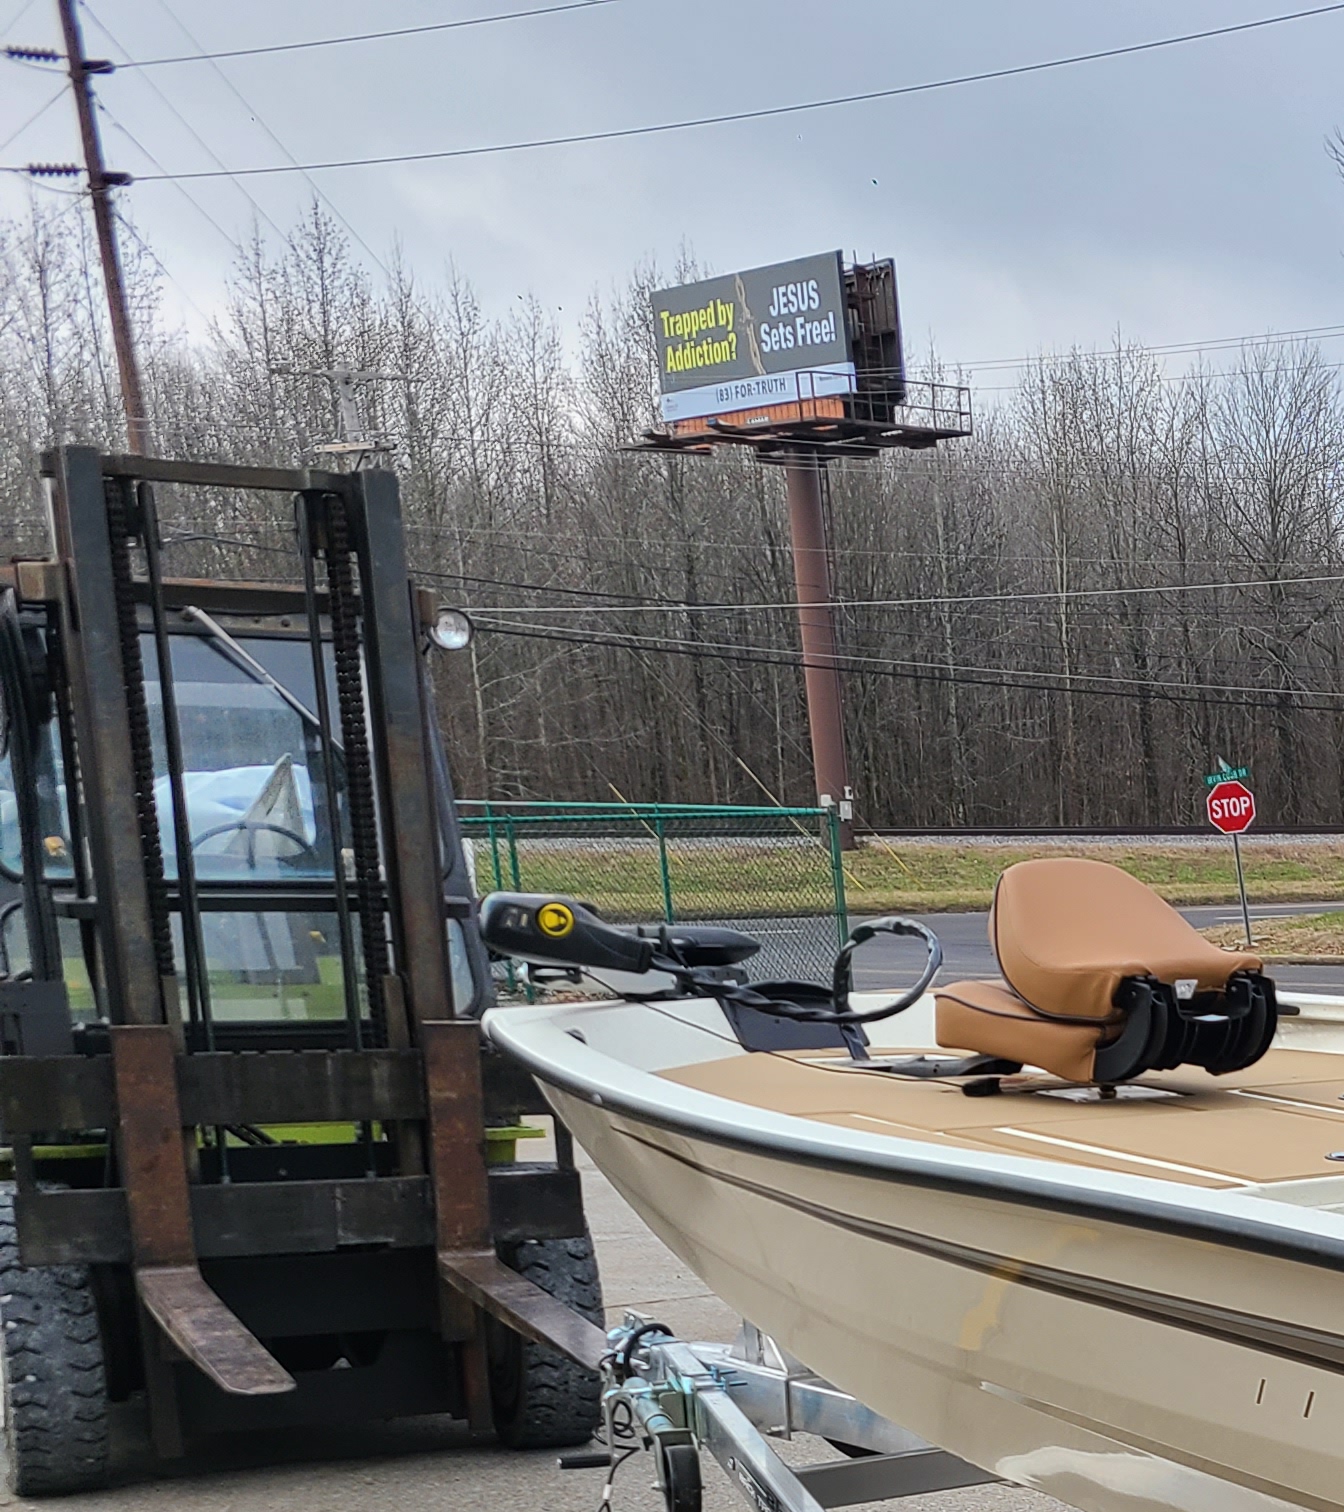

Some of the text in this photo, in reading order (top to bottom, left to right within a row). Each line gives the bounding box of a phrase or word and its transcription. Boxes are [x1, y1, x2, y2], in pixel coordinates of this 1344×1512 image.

[769, 279, 820, 317] JESUS
[660, 298, 734, 341] Trapped by
[760, 311, 836, 353] Sets Free!
[665, 332, 737, 374] Addiction?
[735, 377, 787, 399] FOR-TRUTH
[1211, 796, 1250, 819] STOP
